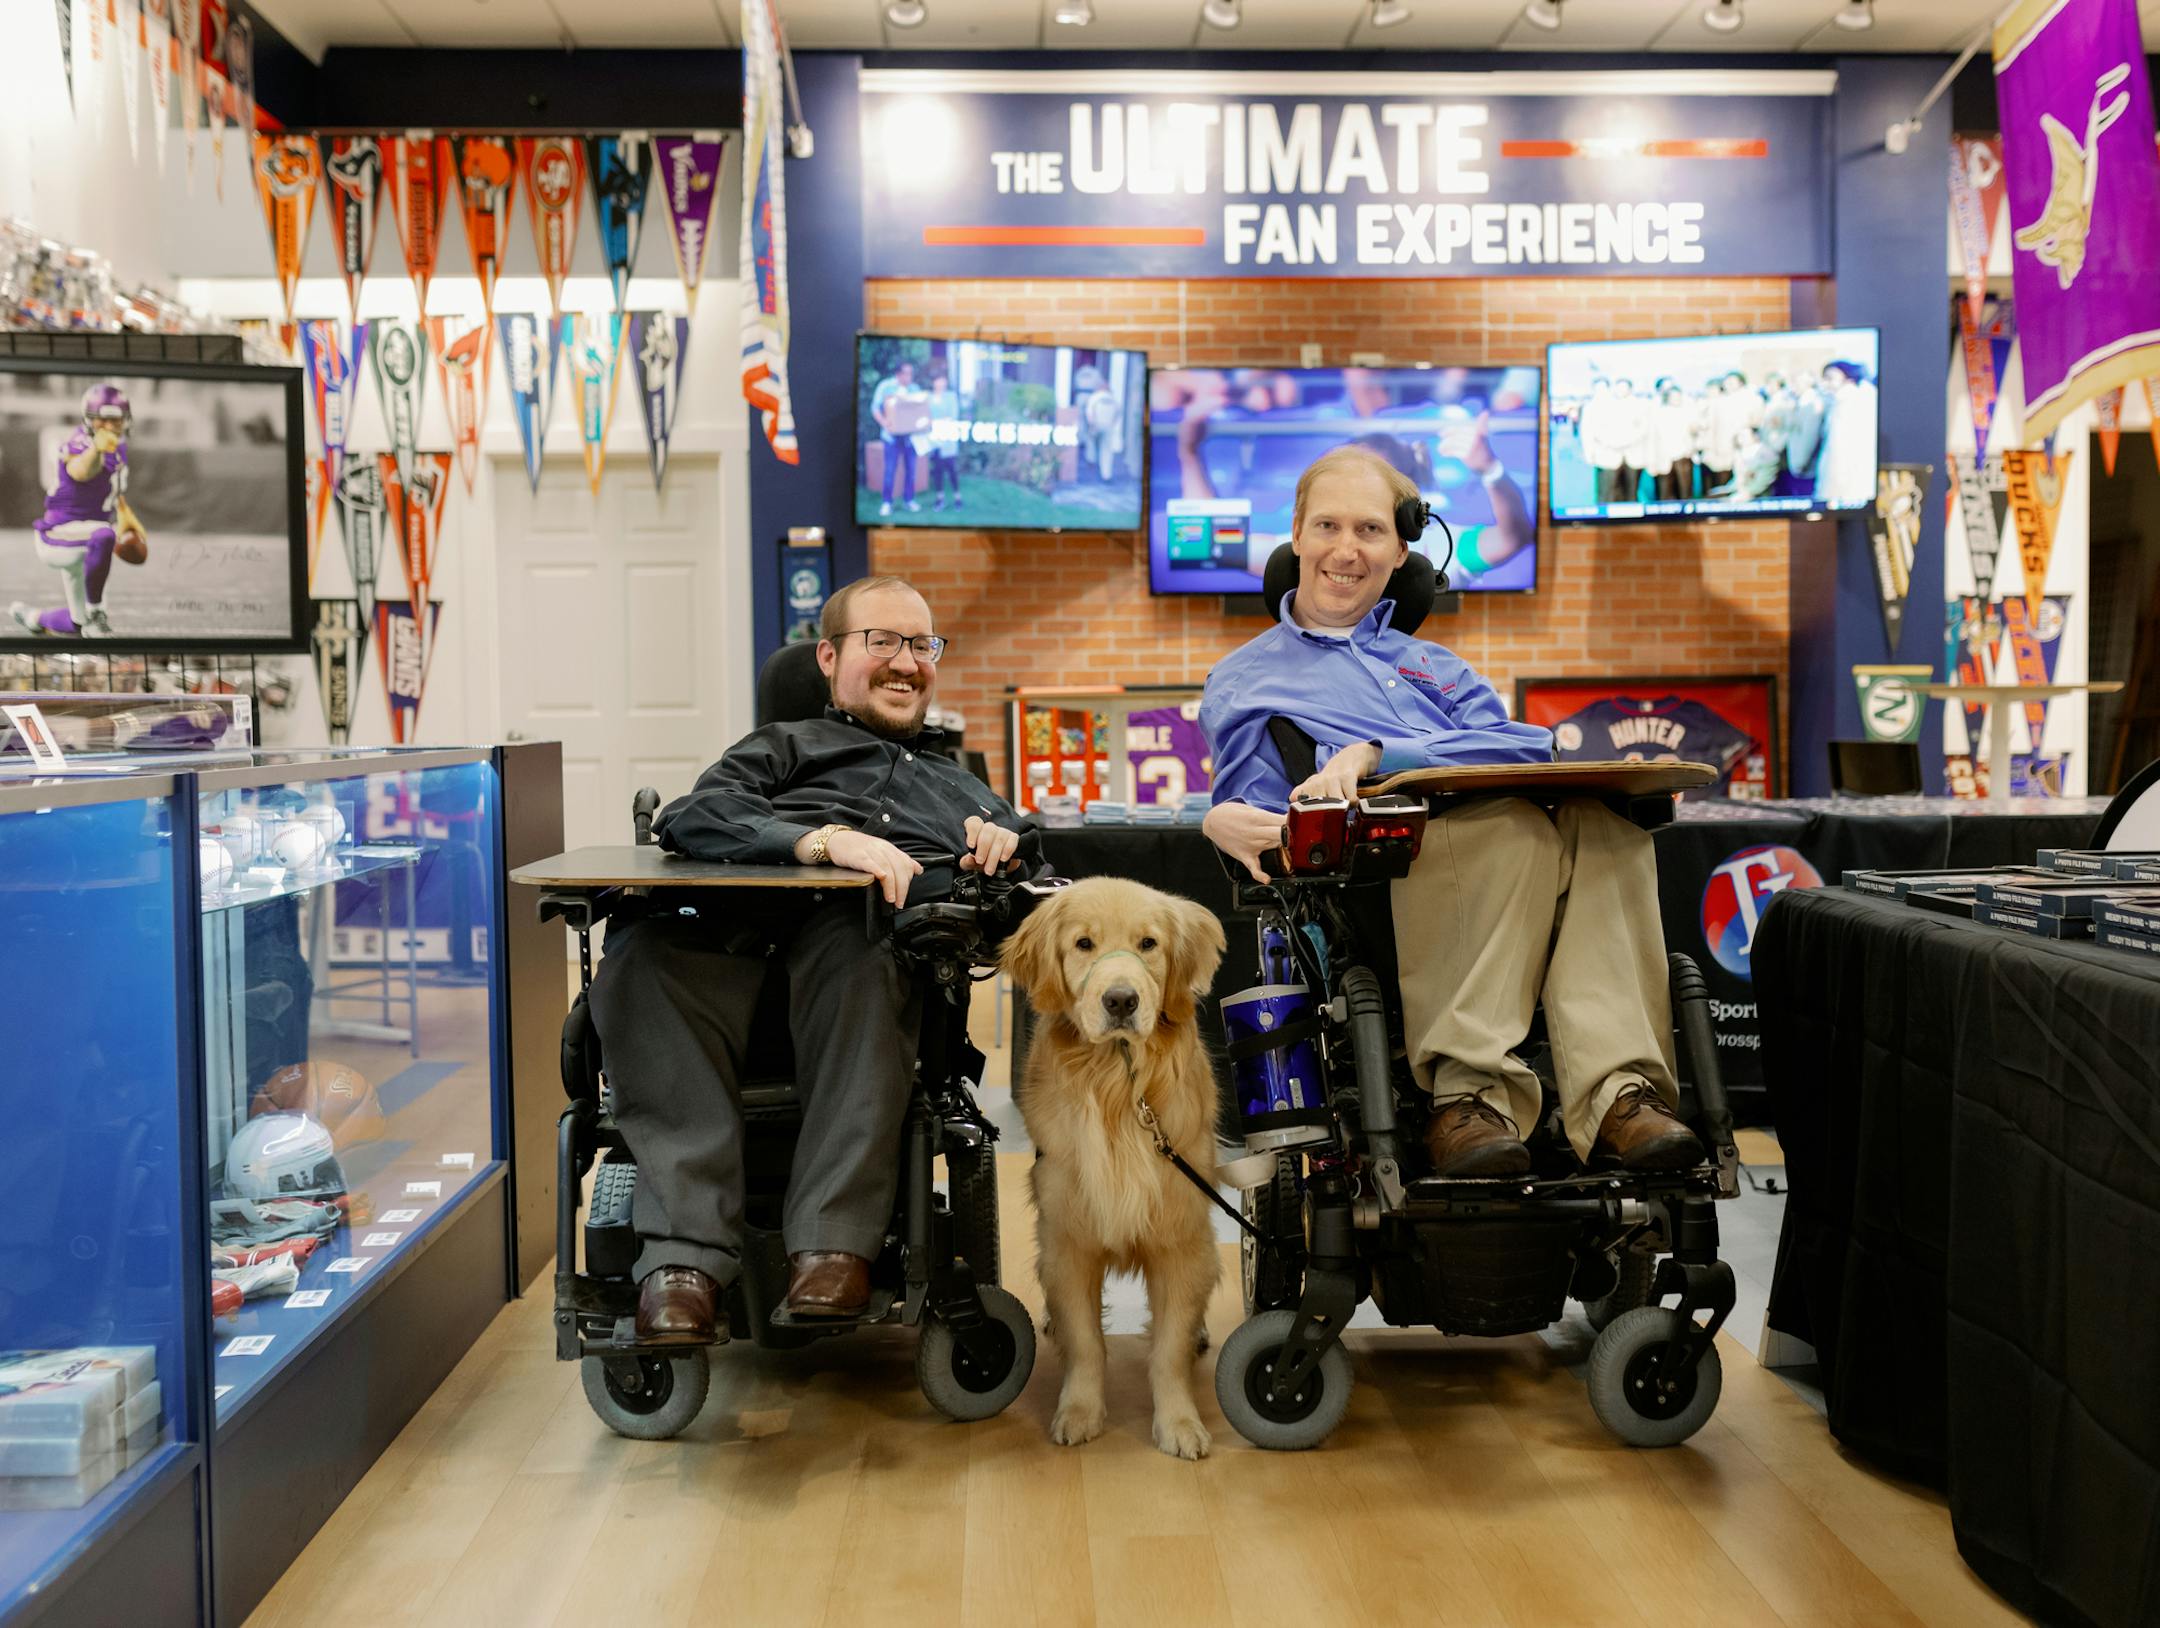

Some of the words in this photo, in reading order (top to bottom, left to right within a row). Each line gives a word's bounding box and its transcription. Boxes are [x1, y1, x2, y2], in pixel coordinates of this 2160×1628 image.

[991, 152, 1063, 194] THE
[1070, 103, 1490, 194] ULTIMATE
[1224, 204, 1337, 264] FAN
[1356, 203, 1704, 264] EXPERIENCE
[2009, 452, 2044, 575] DUCKS
[395, 616, 422, 699] GIANTS
[1608, 717, 1686, 750] HUNTER
